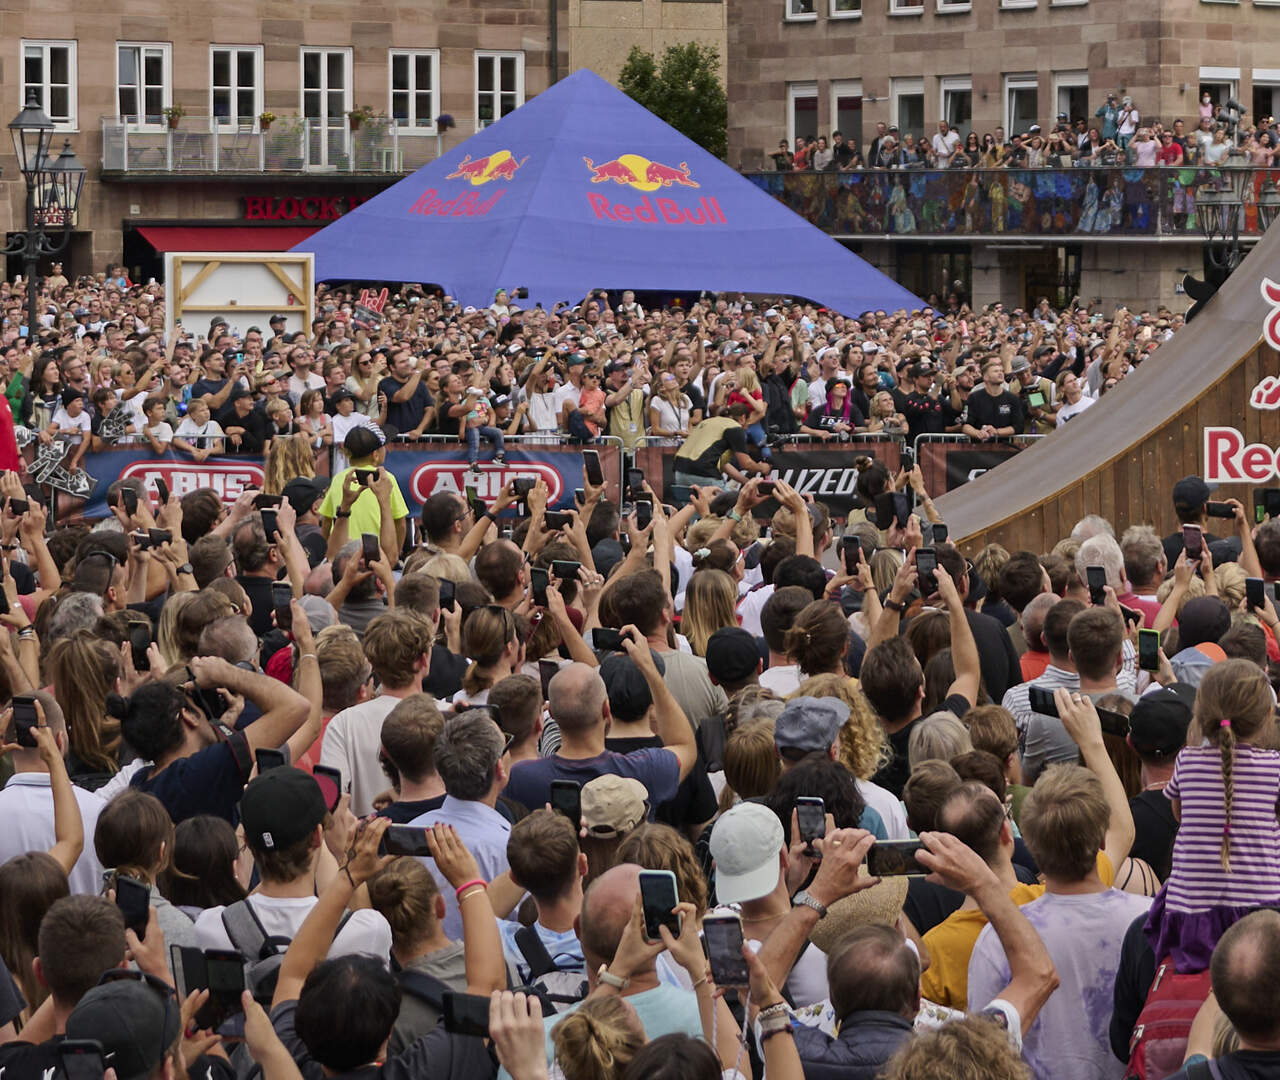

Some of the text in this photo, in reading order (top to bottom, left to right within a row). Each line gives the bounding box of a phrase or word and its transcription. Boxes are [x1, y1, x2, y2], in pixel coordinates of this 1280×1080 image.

[244, 196, 343, 220] BLOCK
[586, 191, 728, 225] Red Bull
[144, 471, 252, 499] ABUS
[430, 471, 542, 497] ABU
